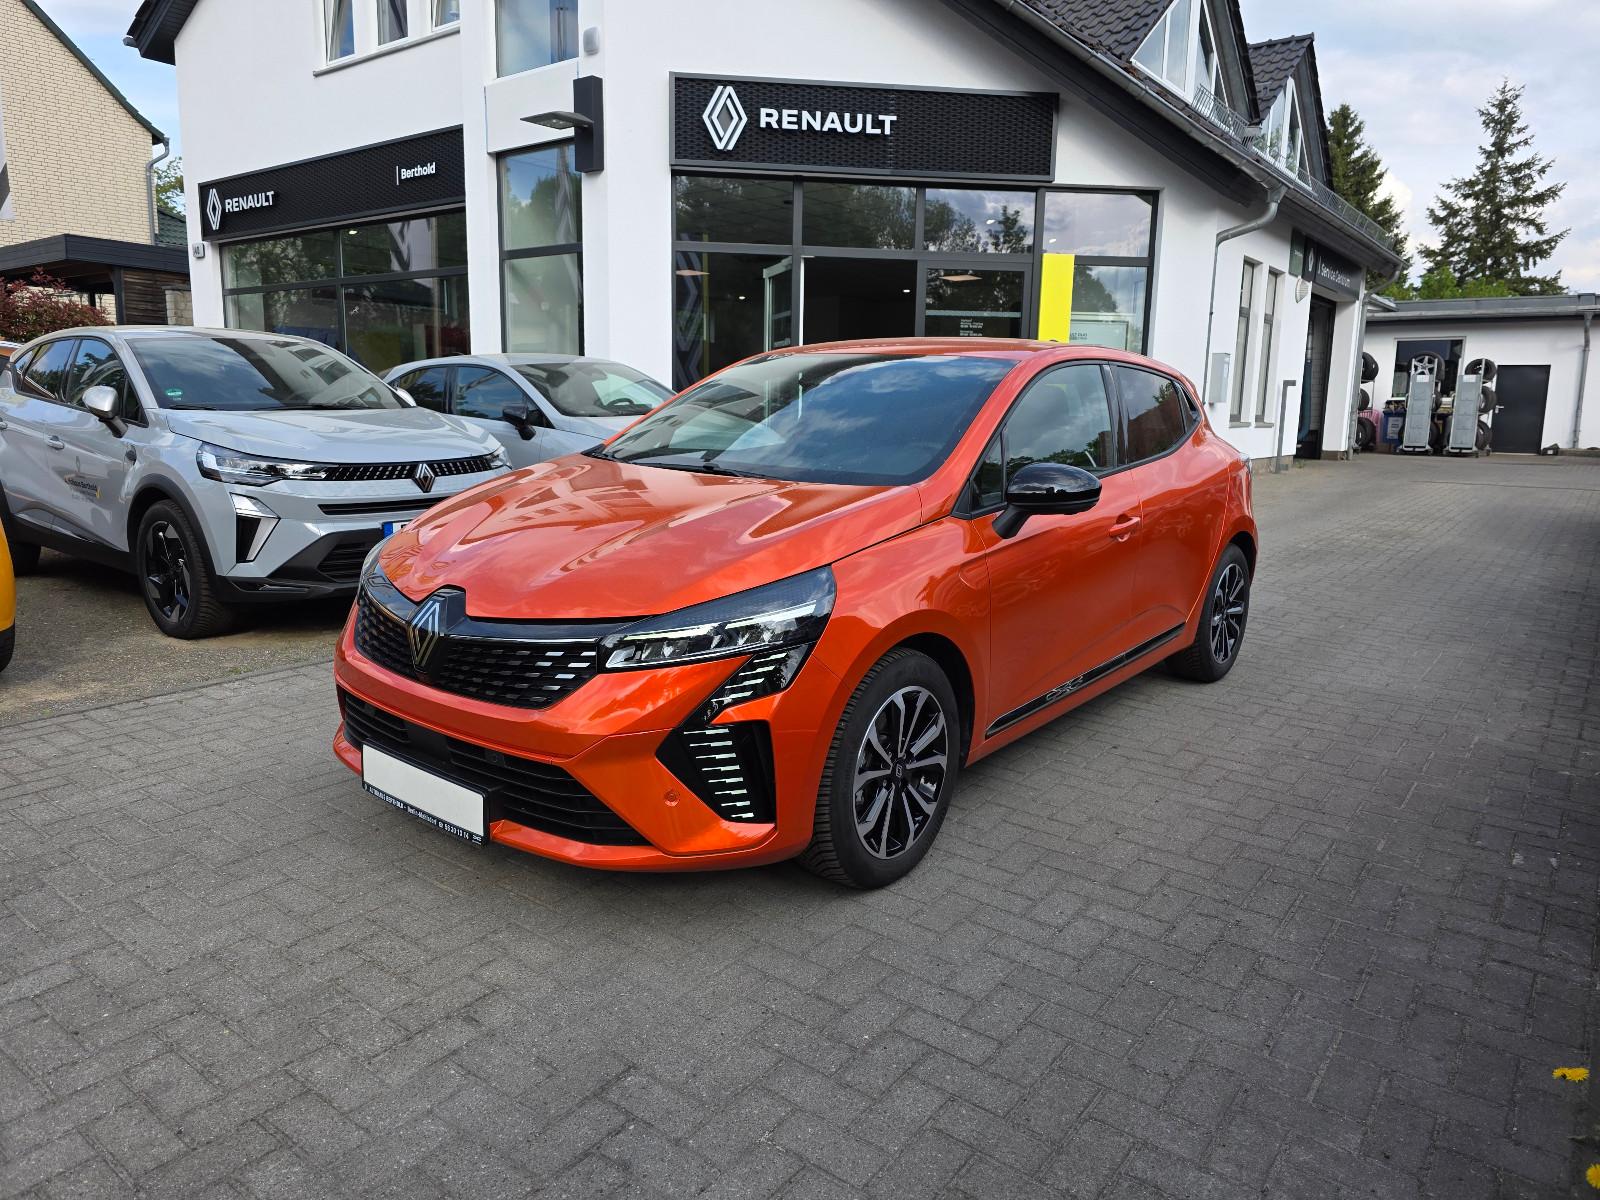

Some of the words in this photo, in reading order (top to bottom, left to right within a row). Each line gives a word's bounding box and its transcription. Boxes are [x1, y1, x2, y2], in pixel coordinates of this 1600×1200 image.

[759, 107, 898, 135] RENAULT
[400, 161, 436, 180] Berthold
[225, 190, 275, 213] RENAULT
